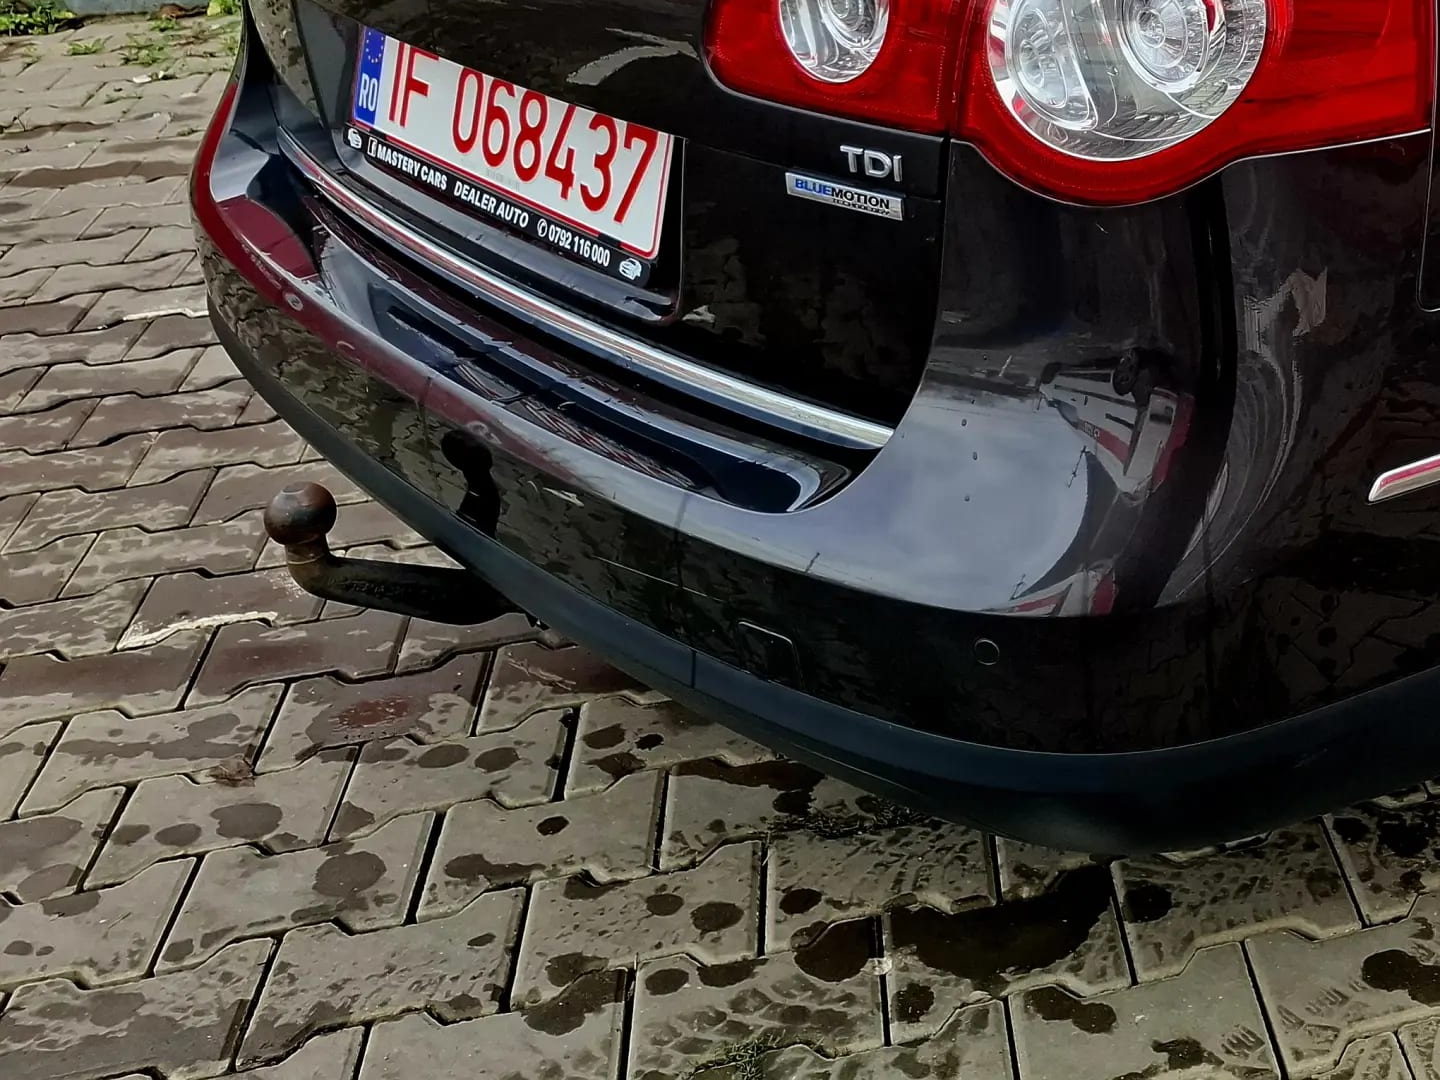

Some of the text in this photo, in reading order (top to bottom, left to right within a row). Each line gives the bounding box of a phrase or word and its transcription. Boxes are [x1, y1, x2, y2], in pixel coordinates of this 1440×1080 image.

[358, 72, 379, 112] RO
[388, 41, 660, 225] IF 068437
[839, 144, 903, 183] TDI
[377, 143, 421, 177] MASTERY
[420, 165, 448, 191] CARS
[453, 180, 497, 214] DEALER
[496, 201, 530, 228] AUTO
[549, 224, 572, 250] 0792
[573, 235, 591, 259] 116
[591, 244, 611, 268] 000
[793, 177, 890, 211] BLUEMOTION
